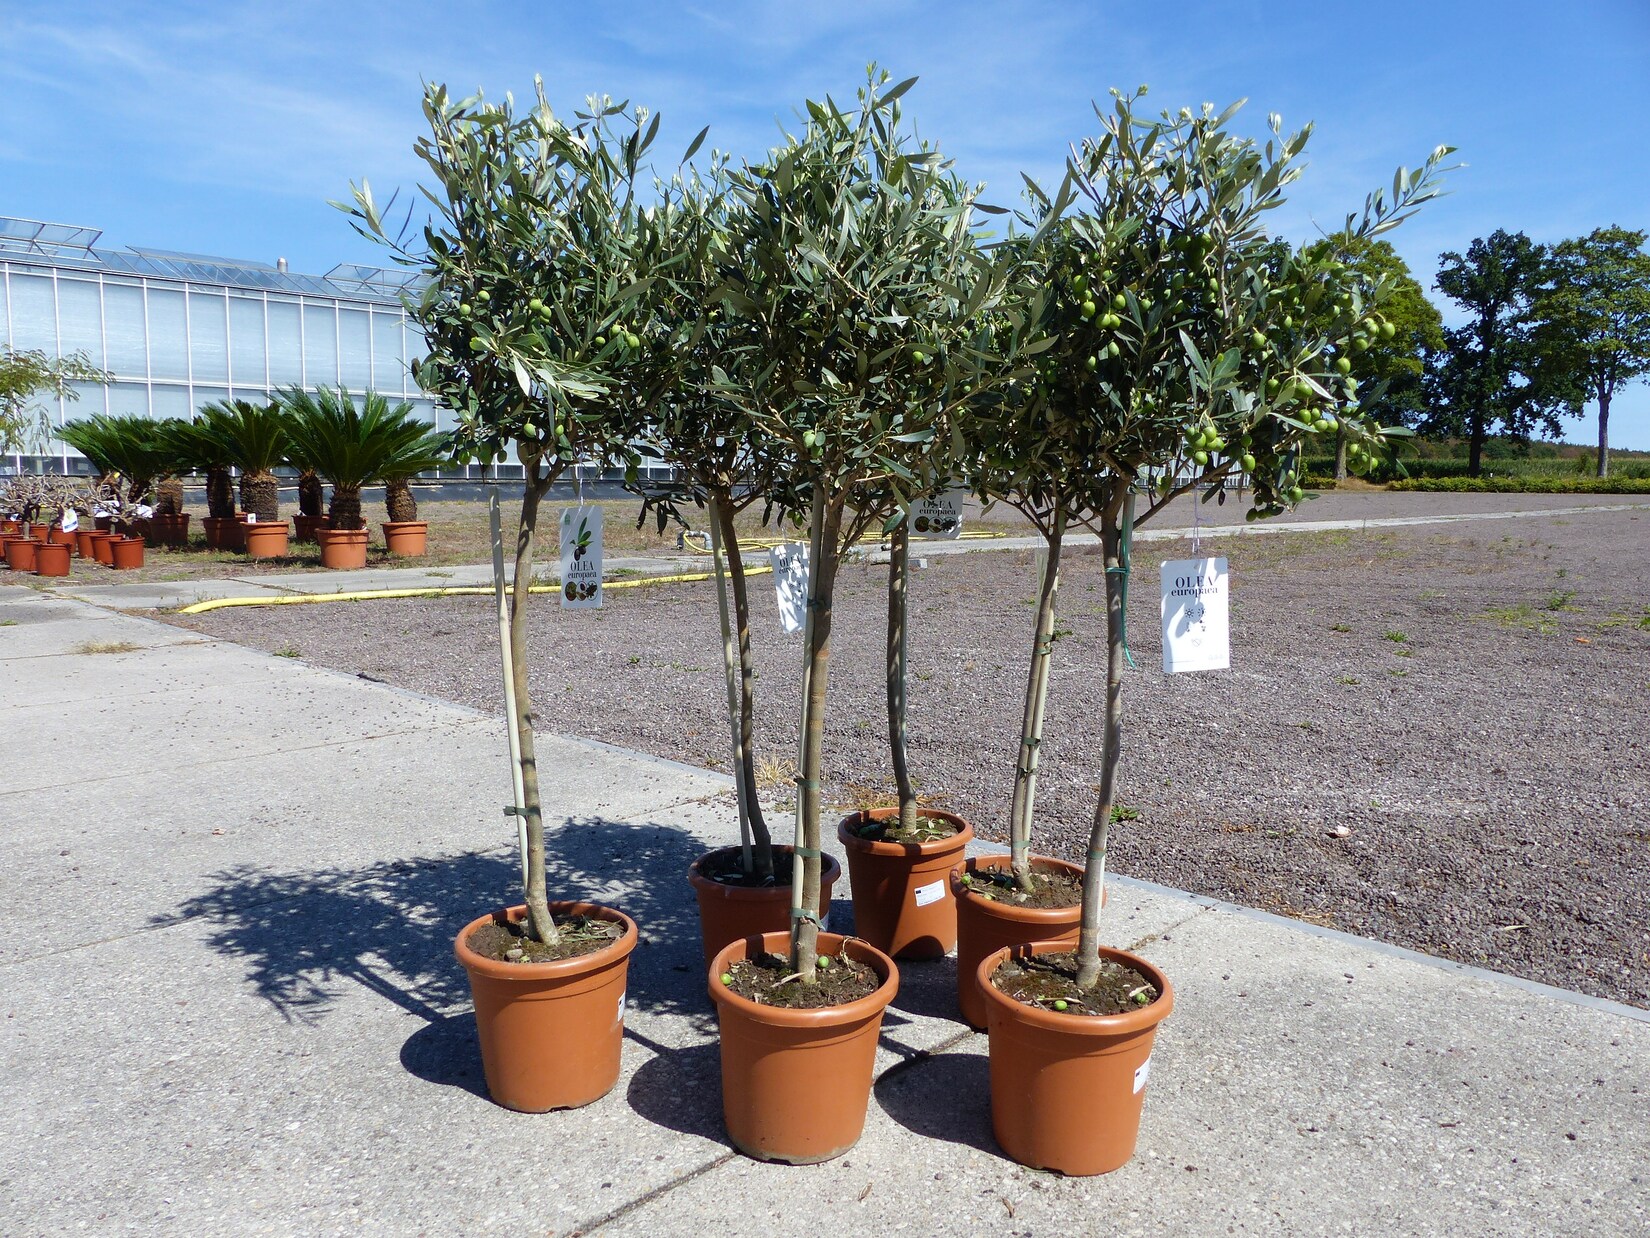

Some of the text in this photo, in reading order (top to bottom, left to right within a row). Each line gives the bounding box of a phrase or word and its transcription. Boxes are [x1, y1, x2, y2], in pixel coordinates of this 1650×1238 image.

[570, 560, 594, 572] OLEA
[567, 571, 597, 580] europaea
[1175, 575, 1213, 588] OLEA
[1171, 586, 1218, 598] europaea
